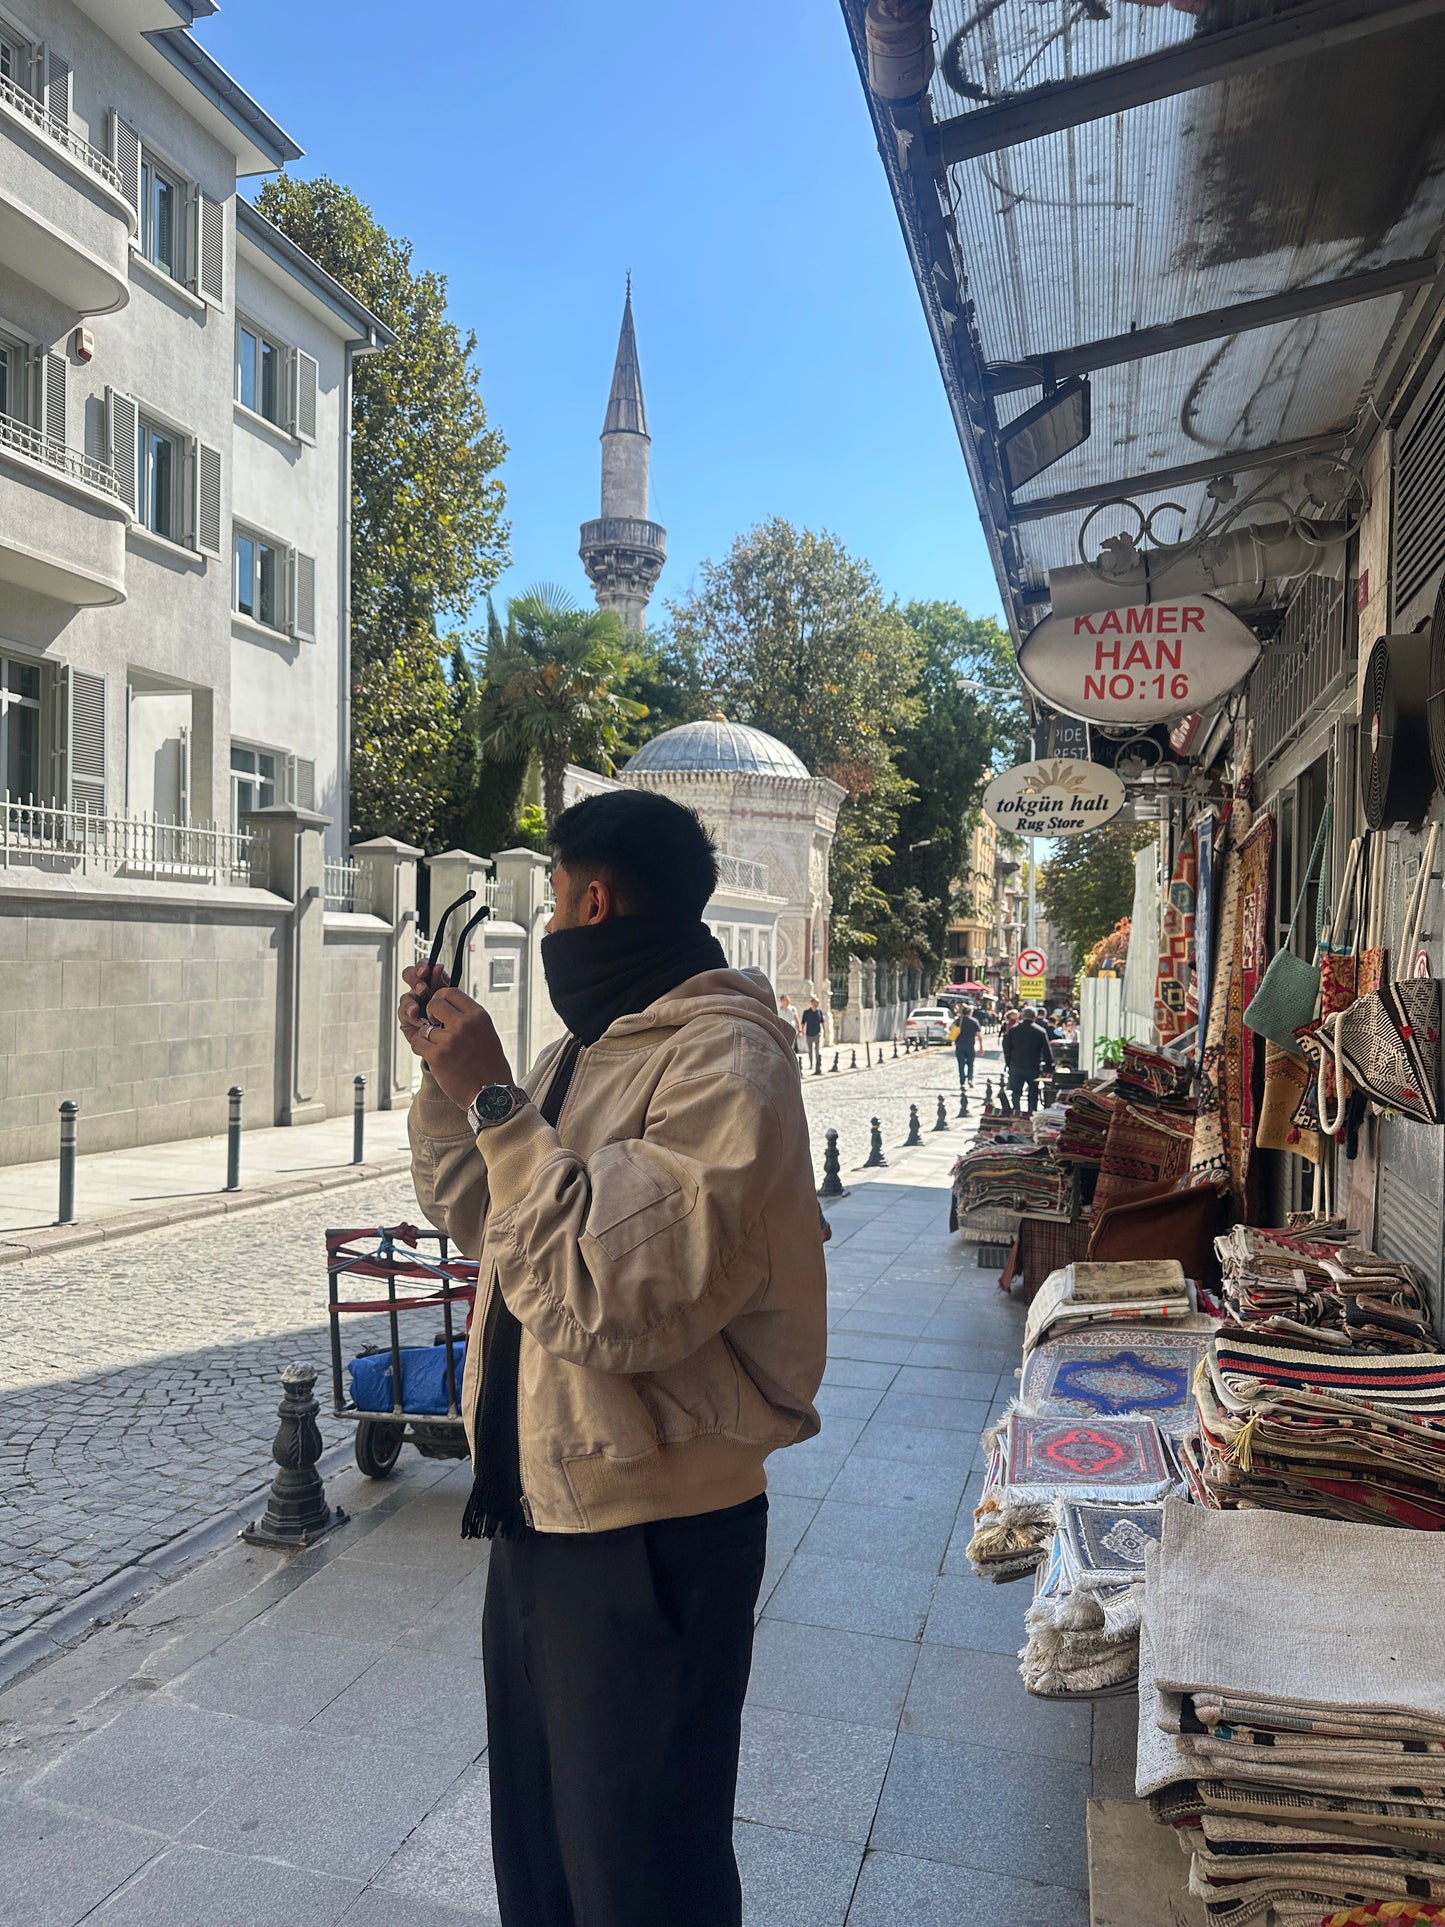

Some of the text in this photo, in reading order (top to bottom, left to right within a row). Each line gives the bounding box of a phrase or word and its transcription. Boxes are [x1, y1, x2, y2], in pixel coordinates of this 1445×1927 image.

[1074, 606, 1206, 635] KAMER
[1094, 640, 1182, 670] HAN
[1083, 674, 1189, 700] NO:16
[996, 794, 1110, 817] tokgün halı
[1015, 816, 1085, 832] Rug Store
